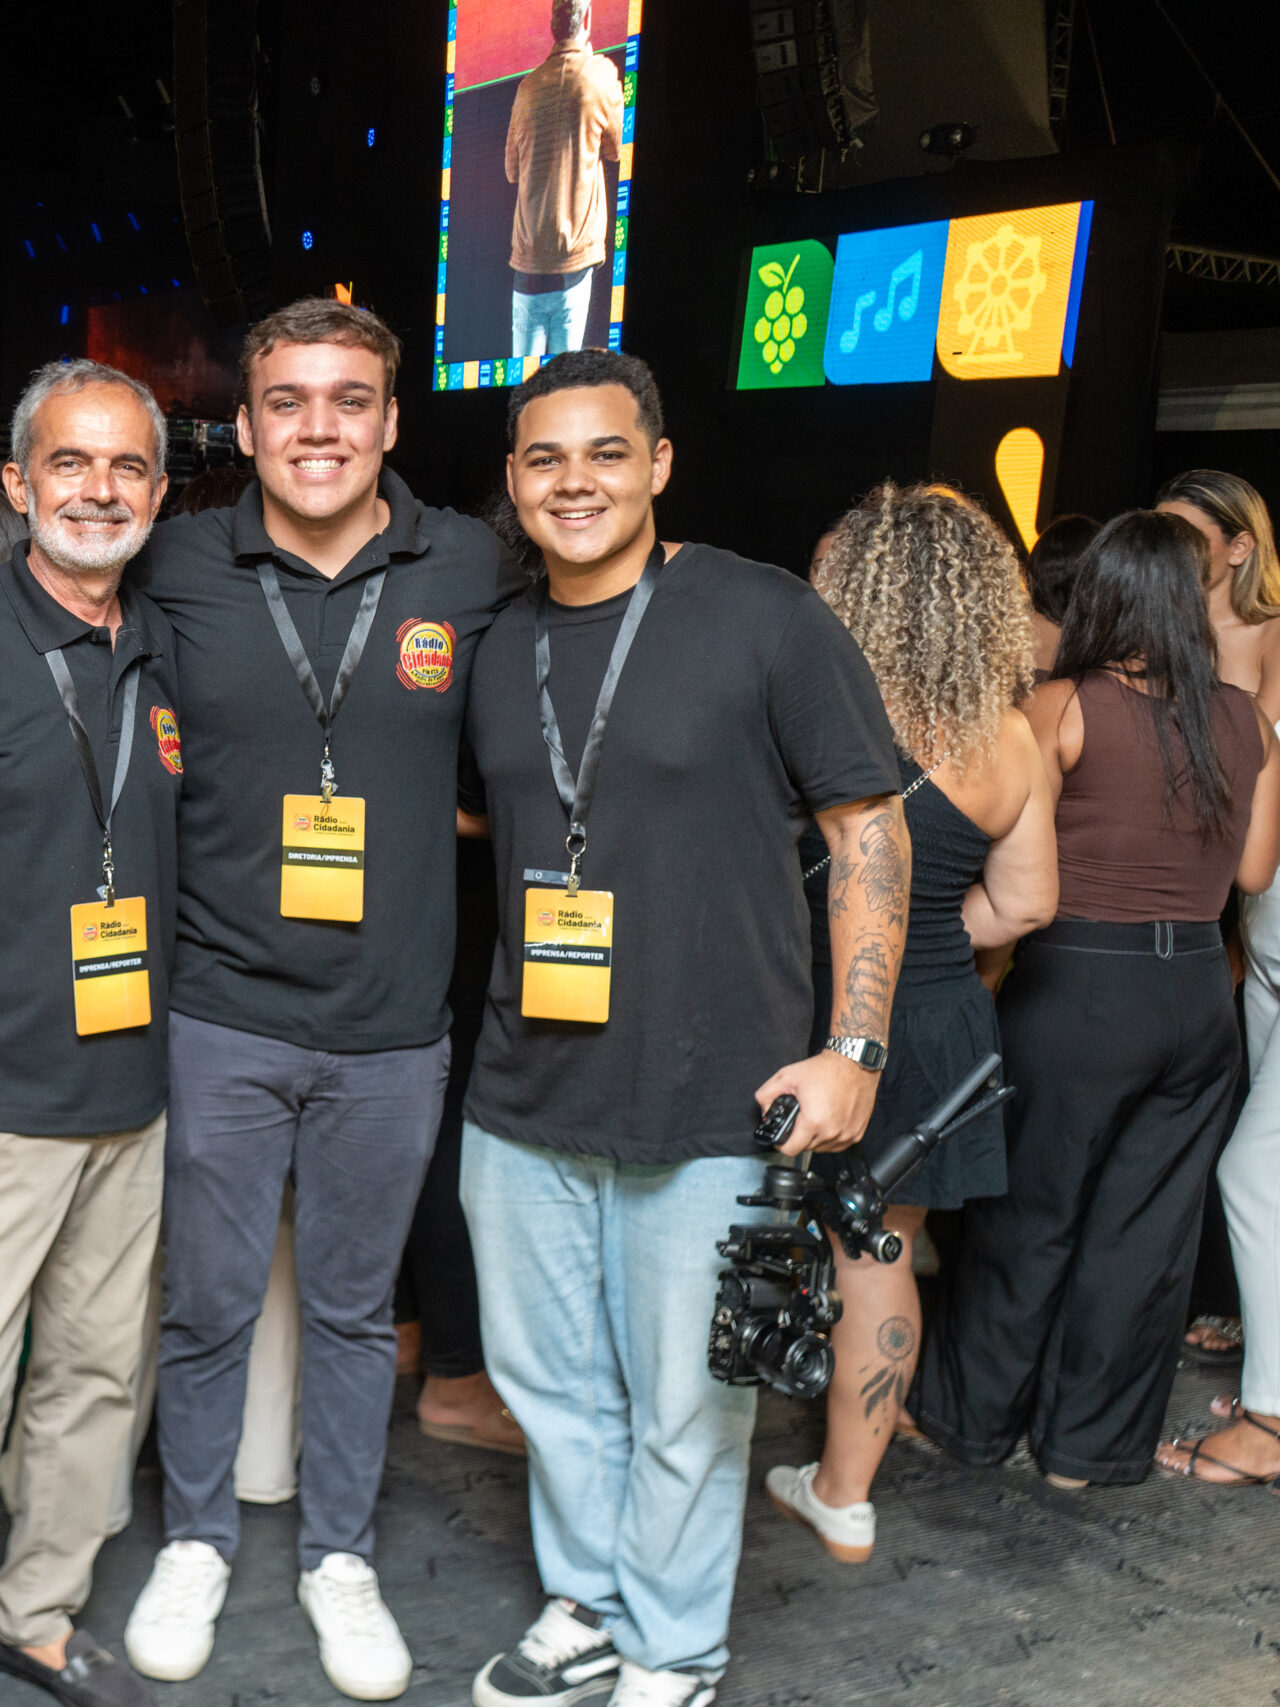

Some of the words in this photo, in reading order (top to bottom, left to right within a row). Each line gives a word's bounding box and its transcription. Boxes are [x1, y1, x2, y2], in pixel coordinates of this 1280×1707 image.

[415, 636, 443, 650] Rádio
[314, 815, 338, 824] Rádio
[313, 824, 355, 833] Cidadania
[287, 852, 358, 863] DIRETORIA/IMPRENSA
[558, 910, 583, 919] Rádio
[100, 920, 122, 930] Rádio
[557, 918, 602, 928] Cidadania
[100, 927, 138, 938] Cidadania
